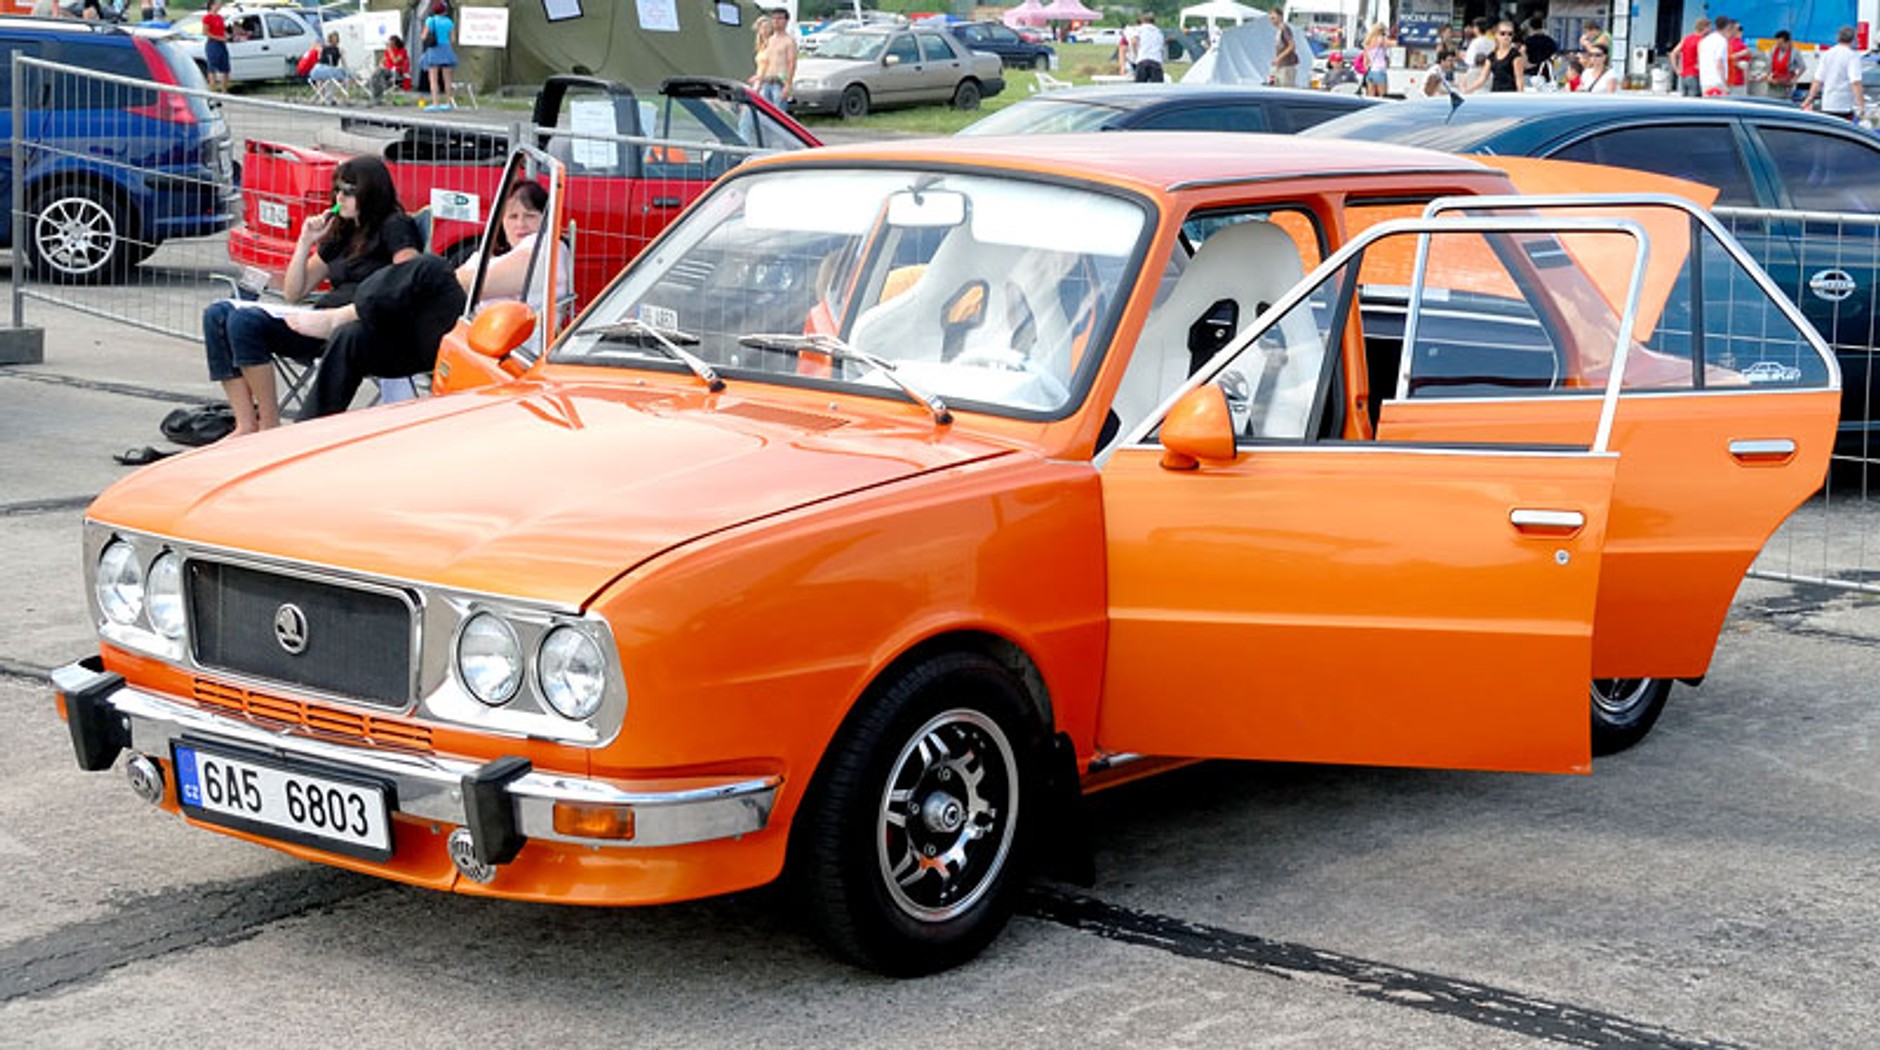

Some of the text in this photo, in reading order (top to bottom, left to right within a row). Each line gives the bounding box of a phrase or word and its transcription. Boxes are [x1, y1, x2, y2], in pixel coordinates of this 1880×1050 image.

[183, 783, 200, 801] CZ
[203, 760, 369, 838] 6A5 6803
